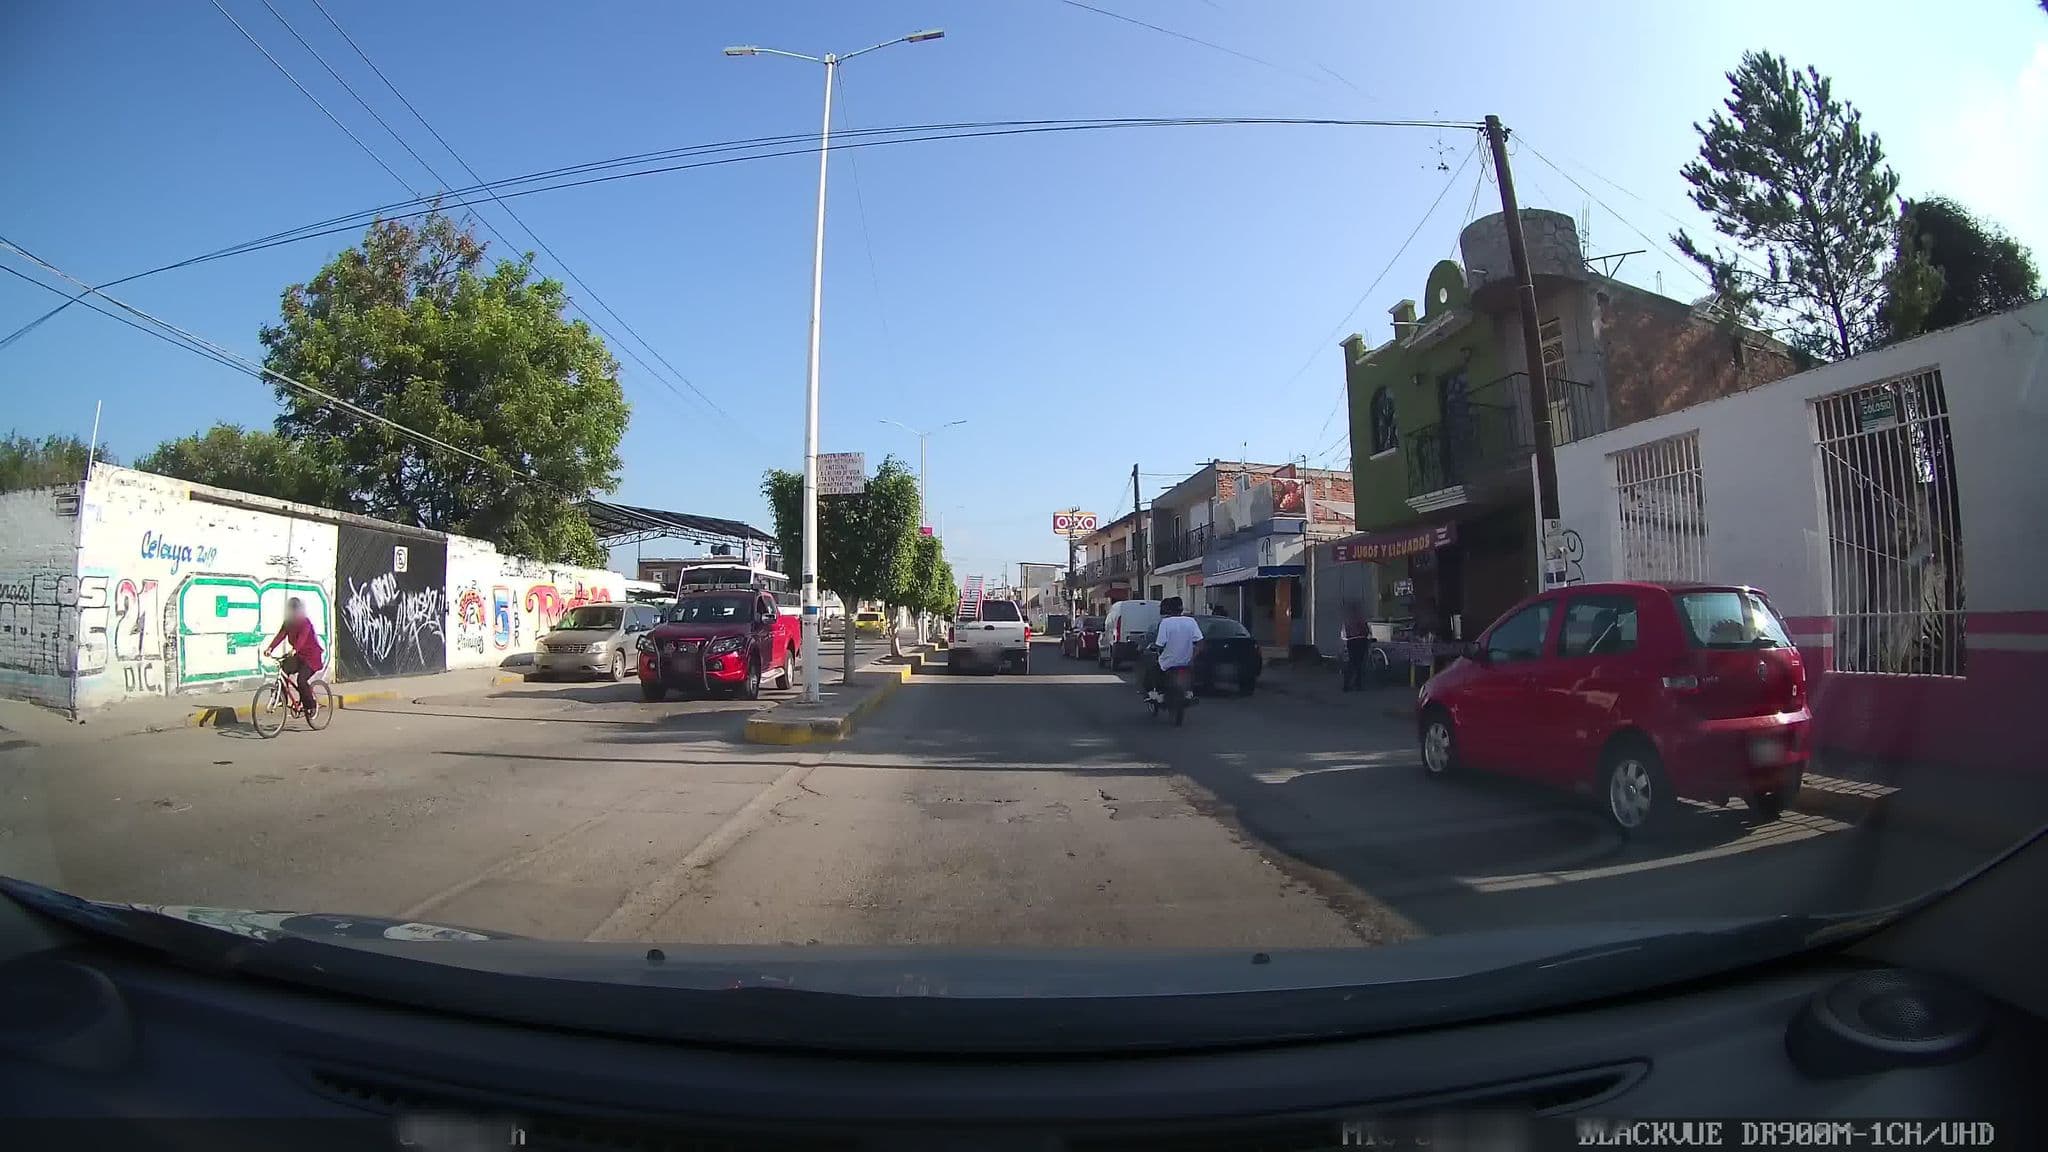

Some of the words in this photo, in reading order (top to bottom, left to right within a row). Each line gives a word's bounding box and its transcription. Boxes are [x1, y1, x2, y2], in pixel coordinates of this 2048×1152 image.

[1057, 516, 1095, 530] OXXO
[141, 531, 192, 575] Celaya
[1352, 544, 1379, 559] JUGOS
[1381, 546, 1387, 557] Y
[1388, 533, 1431, 557] LICUADOS
[115, 579, 163, 661] 21
